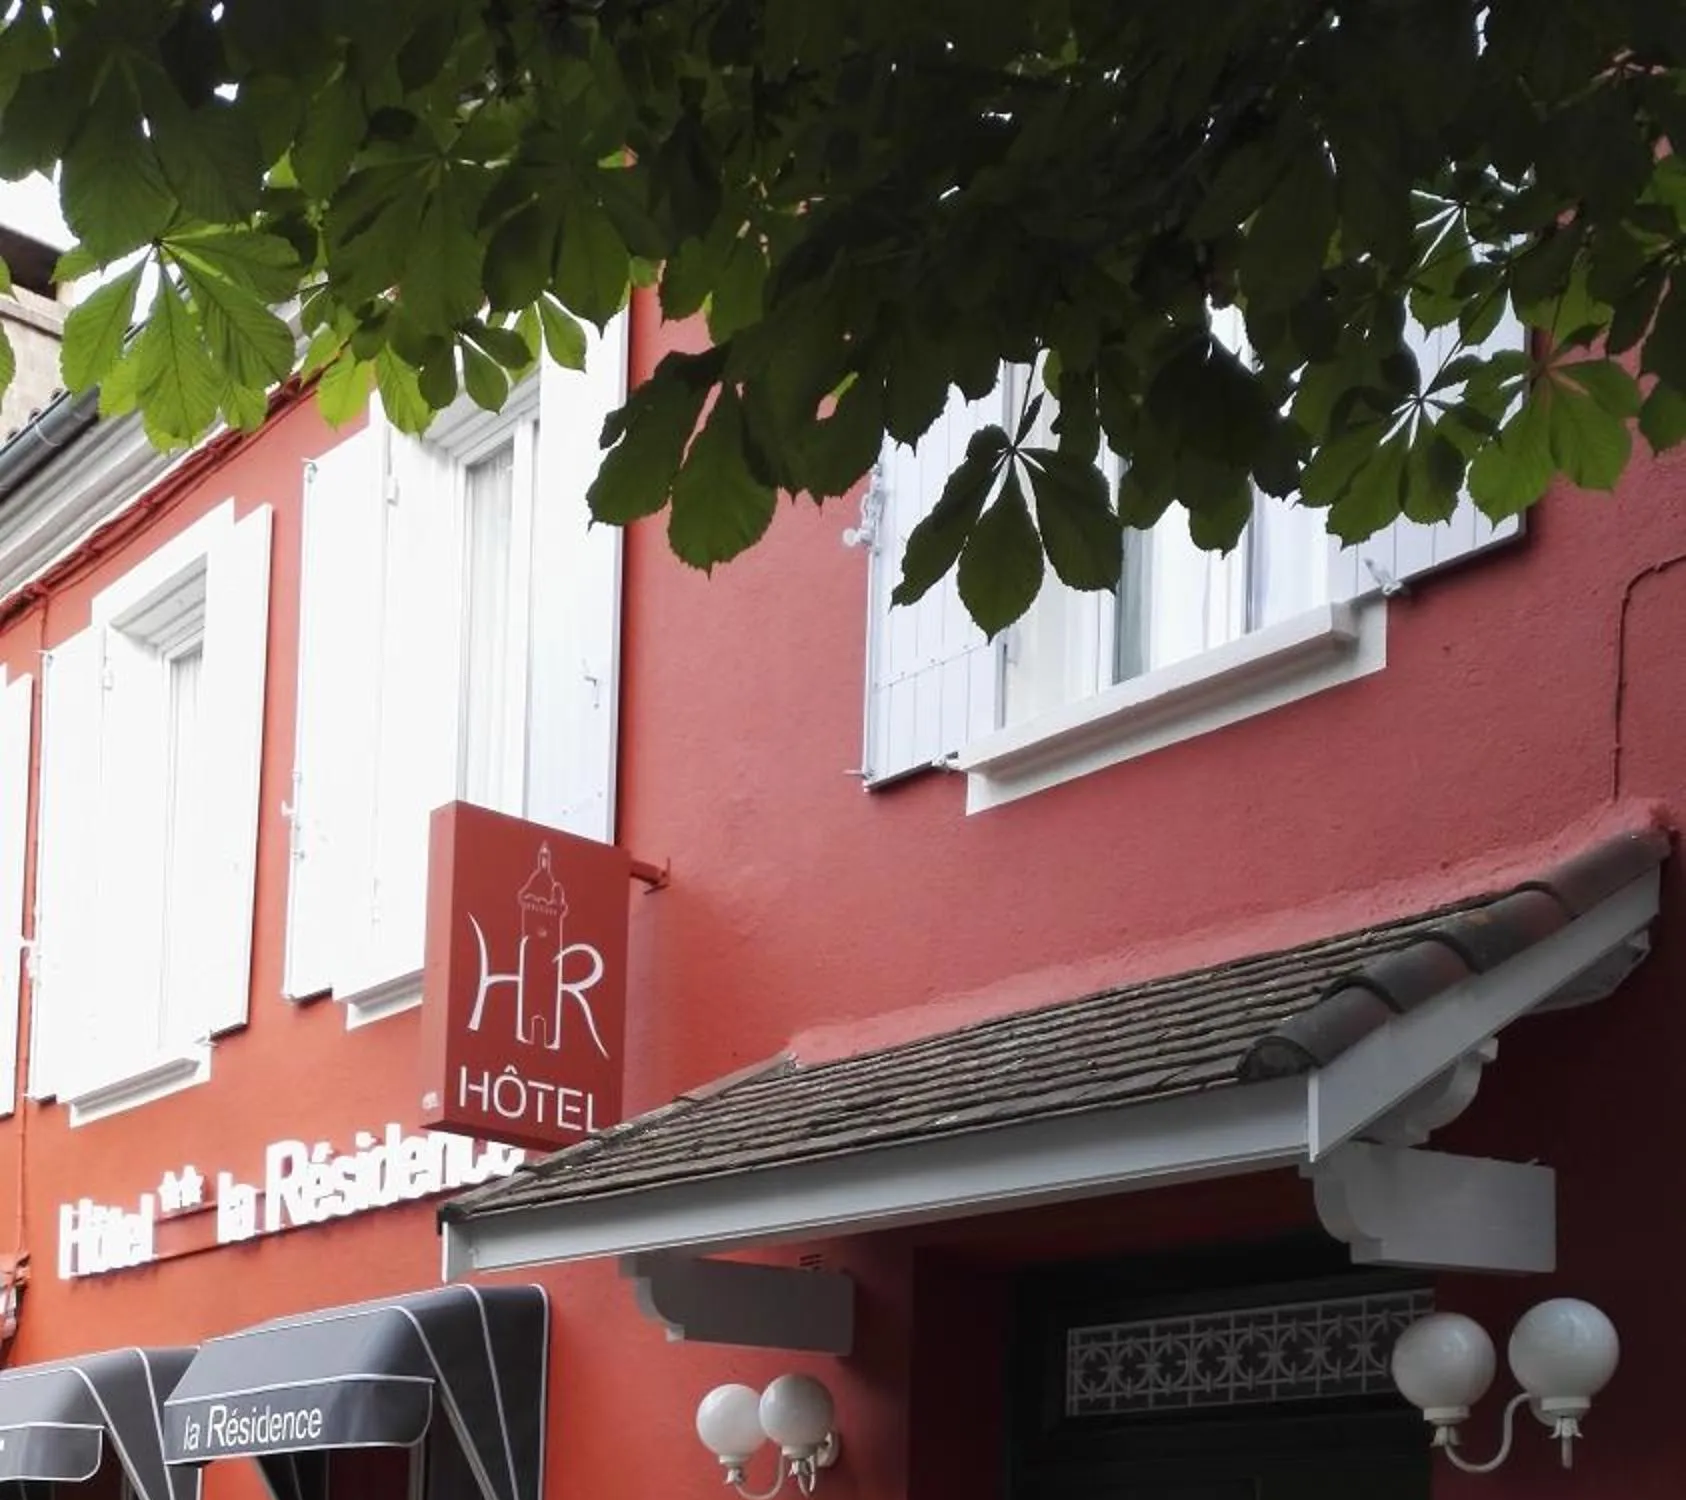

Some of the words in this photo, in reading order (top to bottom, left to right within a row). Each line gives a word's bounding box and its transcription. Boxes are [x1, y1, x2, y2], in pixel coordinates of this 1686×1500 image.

[459, 1064, 599, 1132] HÔTEL
[217, 1171, 257, 1243] la
[266, 1123, 525, 1231] Résidence
[183, 1416, 199, 1450] la
[207, 1404, 322, 1449] Résidence
